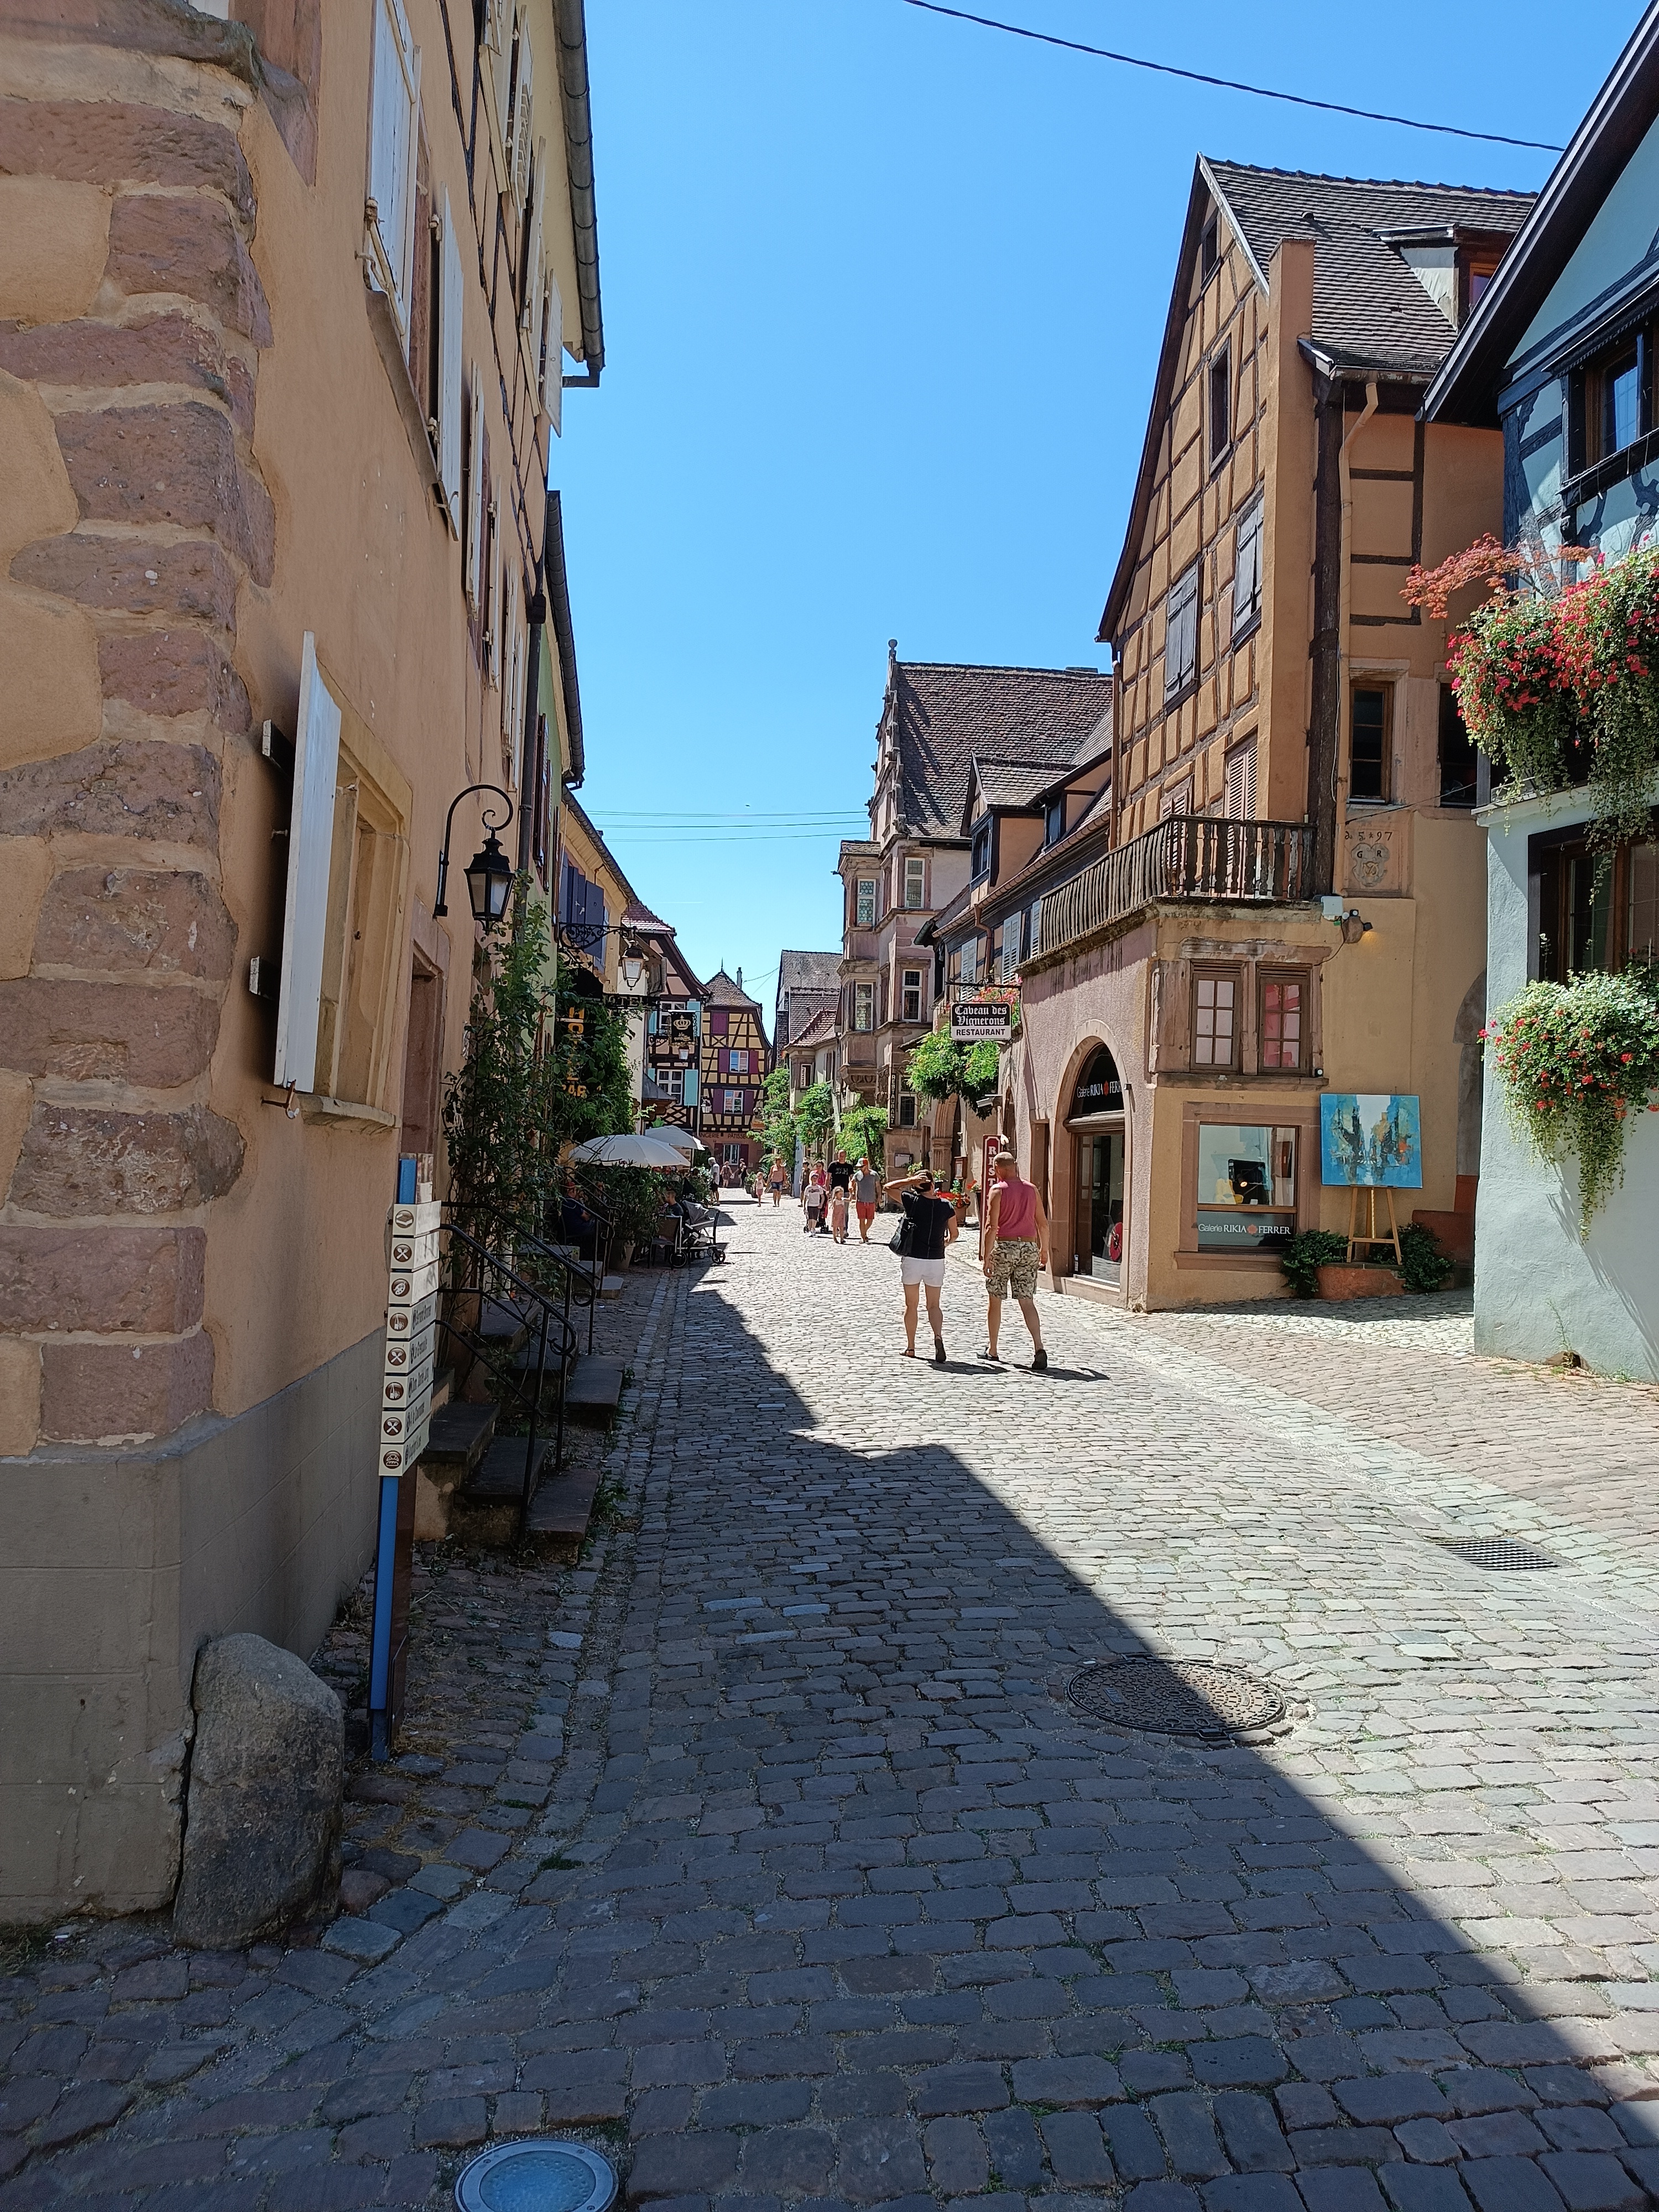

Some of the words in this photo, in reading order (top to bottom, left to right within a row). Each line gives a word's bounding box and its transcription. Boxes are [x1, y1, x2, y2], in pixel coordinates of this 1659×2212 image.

[954, 1005, 989, 1015] Caveau
[992, 1005, 1008, 1015] des
[956, 1015, 1005, 1026] Vignerons
[1090, 1083, 1103, 1096] RIKIA
[1198, 1223, 1223, 1232] Galerie
[1223, 1224, 1247, 1233] RIKIA
[1258, 1225, 1291, 1234] FERRER
